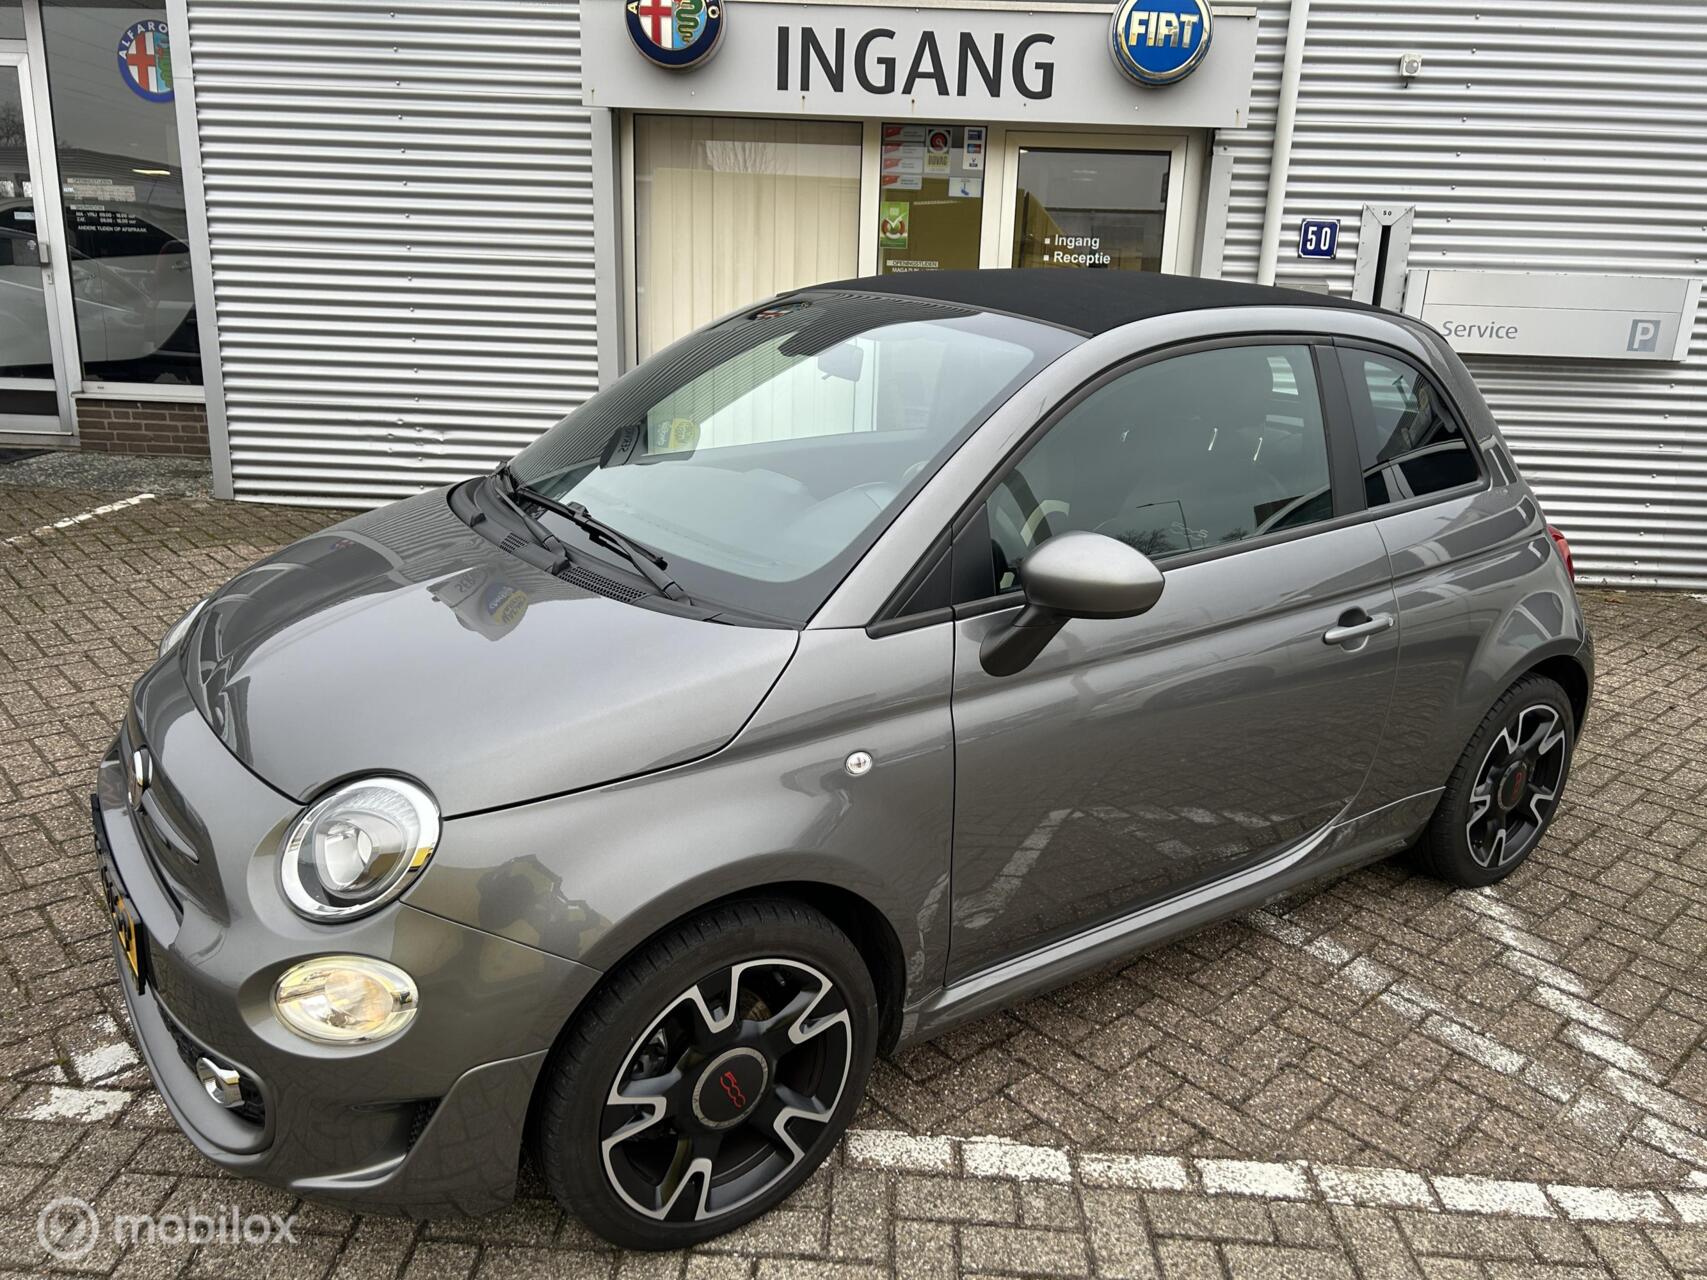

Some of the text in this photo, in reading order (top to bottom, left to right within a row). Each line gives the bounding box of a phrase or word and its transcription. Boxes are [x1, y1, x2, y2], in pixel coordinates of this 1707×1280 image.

[1128, 11, 1199, 48] FIAT
[777, 26, 1055, 100] INGANG
[1055, 234, 1100, 249] Ingang
[1306, 226, 1331, 250] 50
[1053, 251, 1111, 267] Receptie
[1442, 320, 1518, 339] Service
[720, 1071, 746, 1109] 500
